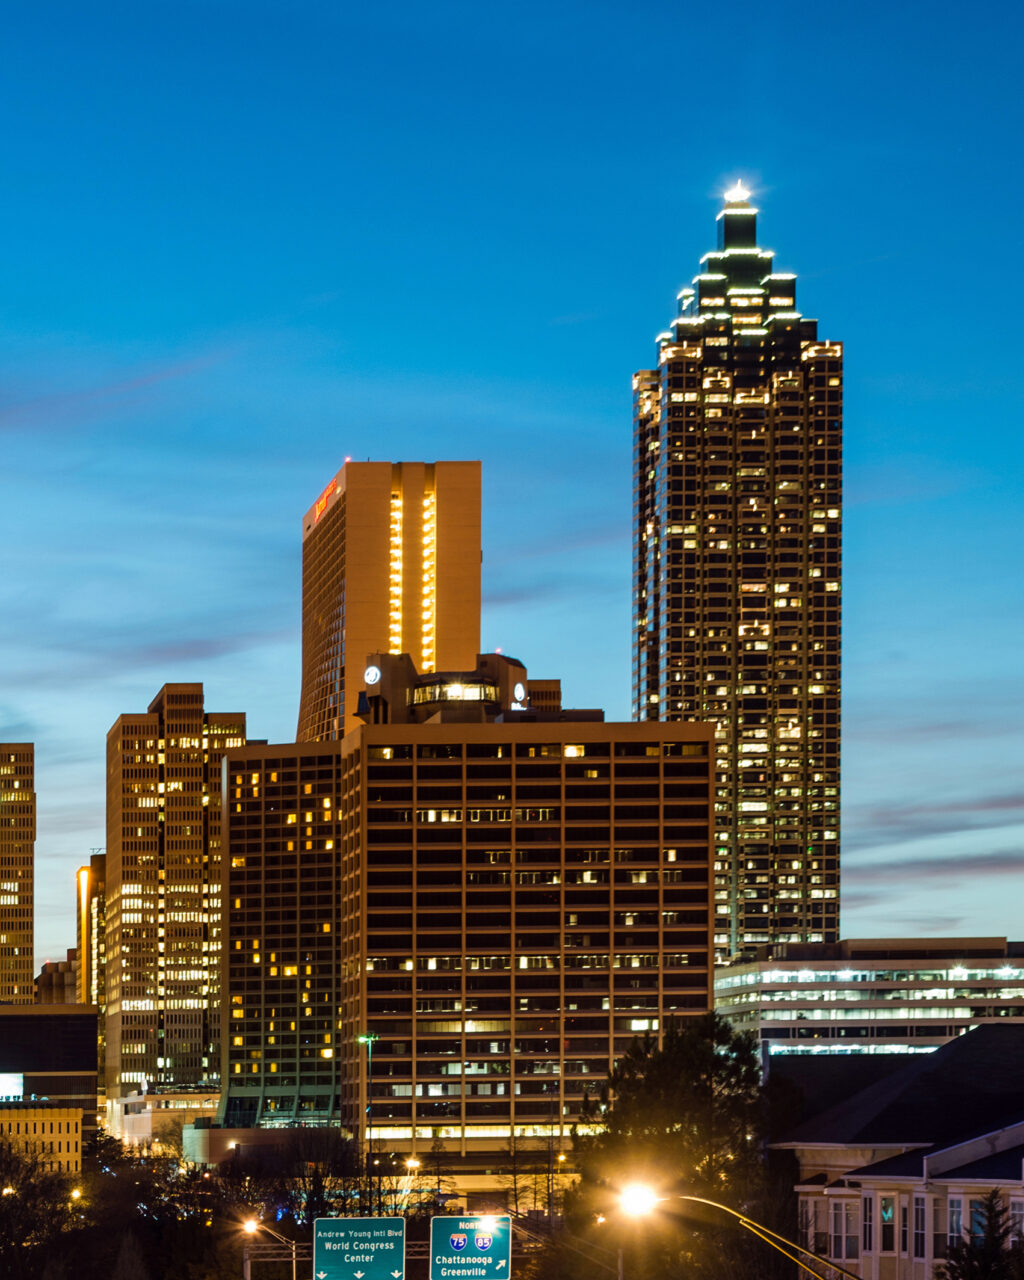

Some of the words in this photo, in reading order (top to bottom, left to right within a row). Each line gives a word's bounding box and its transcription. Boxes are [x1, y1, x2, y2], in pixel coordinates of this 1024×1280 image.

[459, 1221, 484, 1230] NORT
[317, 1231, 345, 1239] Andrew
[348, 1230, 371, 1239] Young
[387, 1229, 403, 1237] Blvd
[325, 1242, 350, 1251] World
[353, 1241, 394, 1252] Congress
[452, 1238, 465, 1247] 75
[477, 1238, 490, 1247] 85
[344, 1254, 374, 1263] Center
[435, 1256, 493, 1266] Chattanooga
[441, 1268, 486, 1277] Greenville
